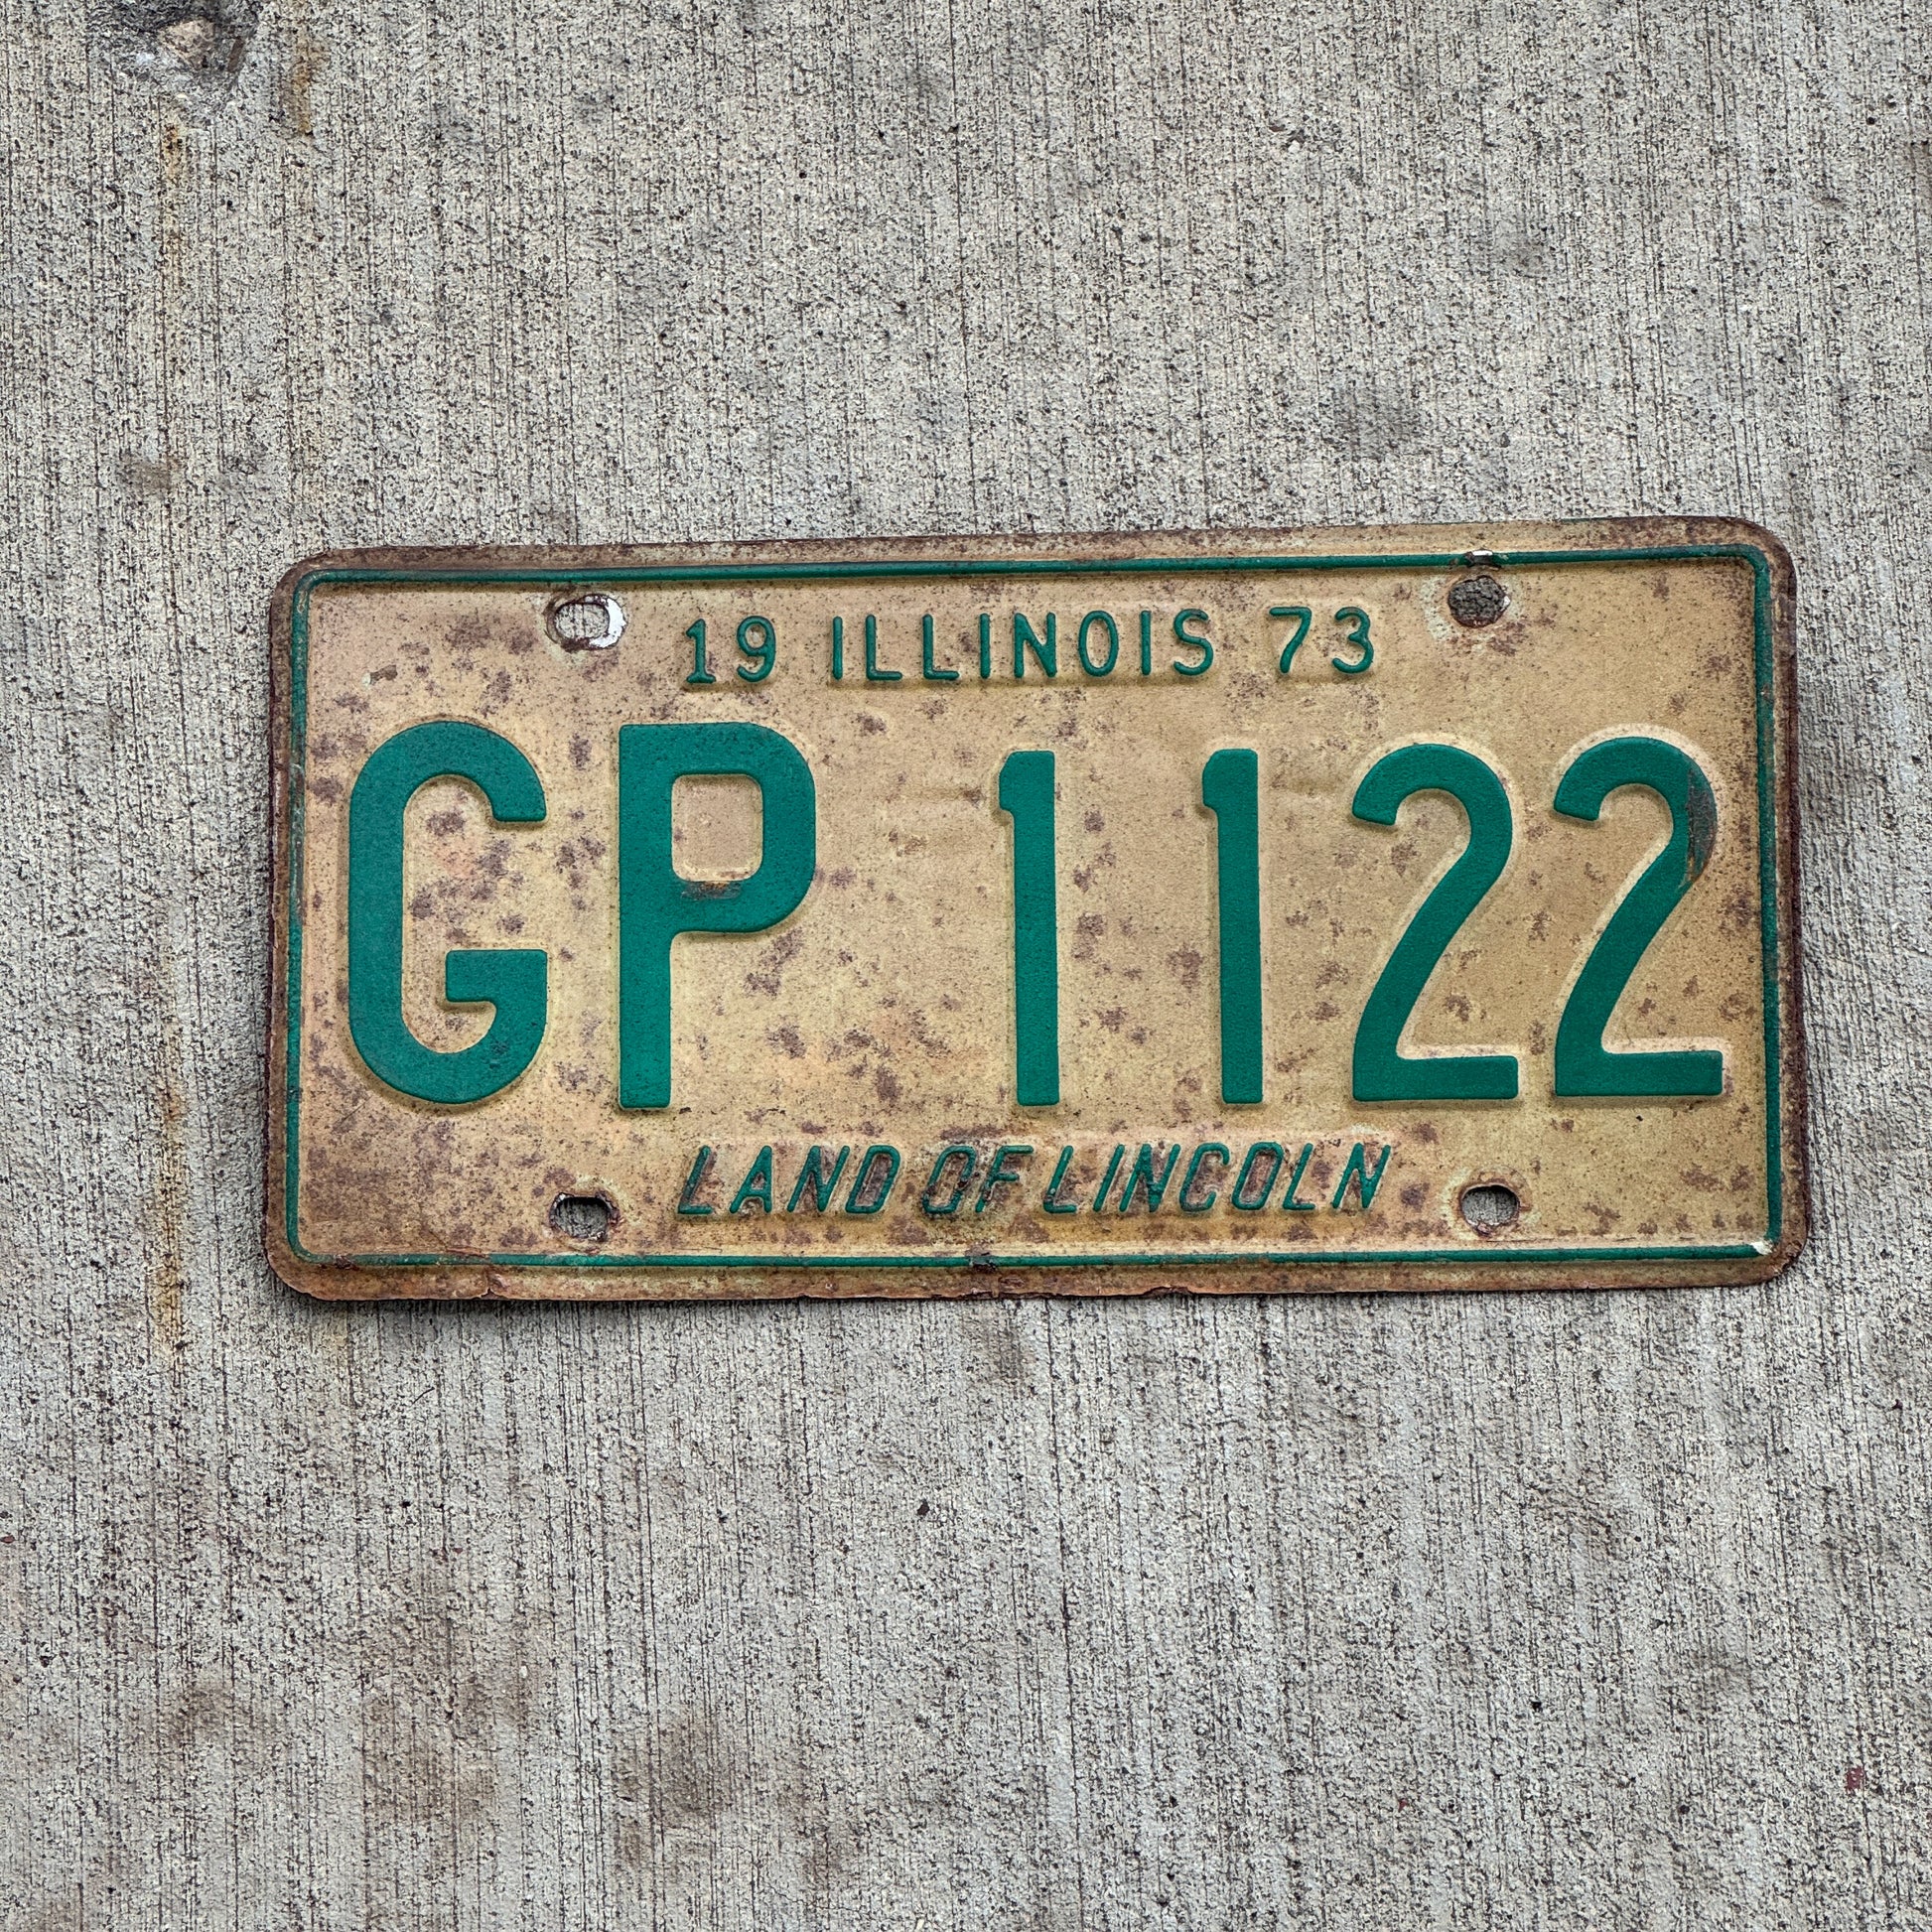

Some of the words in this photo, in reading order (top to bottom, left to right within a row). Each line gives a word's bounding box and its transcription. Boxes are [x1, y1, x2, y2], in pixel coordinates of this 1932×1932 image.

[685, 615, 776, 684] 19
[832, 609, 1215, 682] ILLINOIS
[1269, 607, 1375, 675] 73
[348, 722, 816, 1109] GP
[998, 736, 1723, 1107] 1122
[677, 1145, 901, 1215] LAND
[921, 1145, 1035, 1214] OF
[1043, 1142, 1392, 1214] LINCOLN
